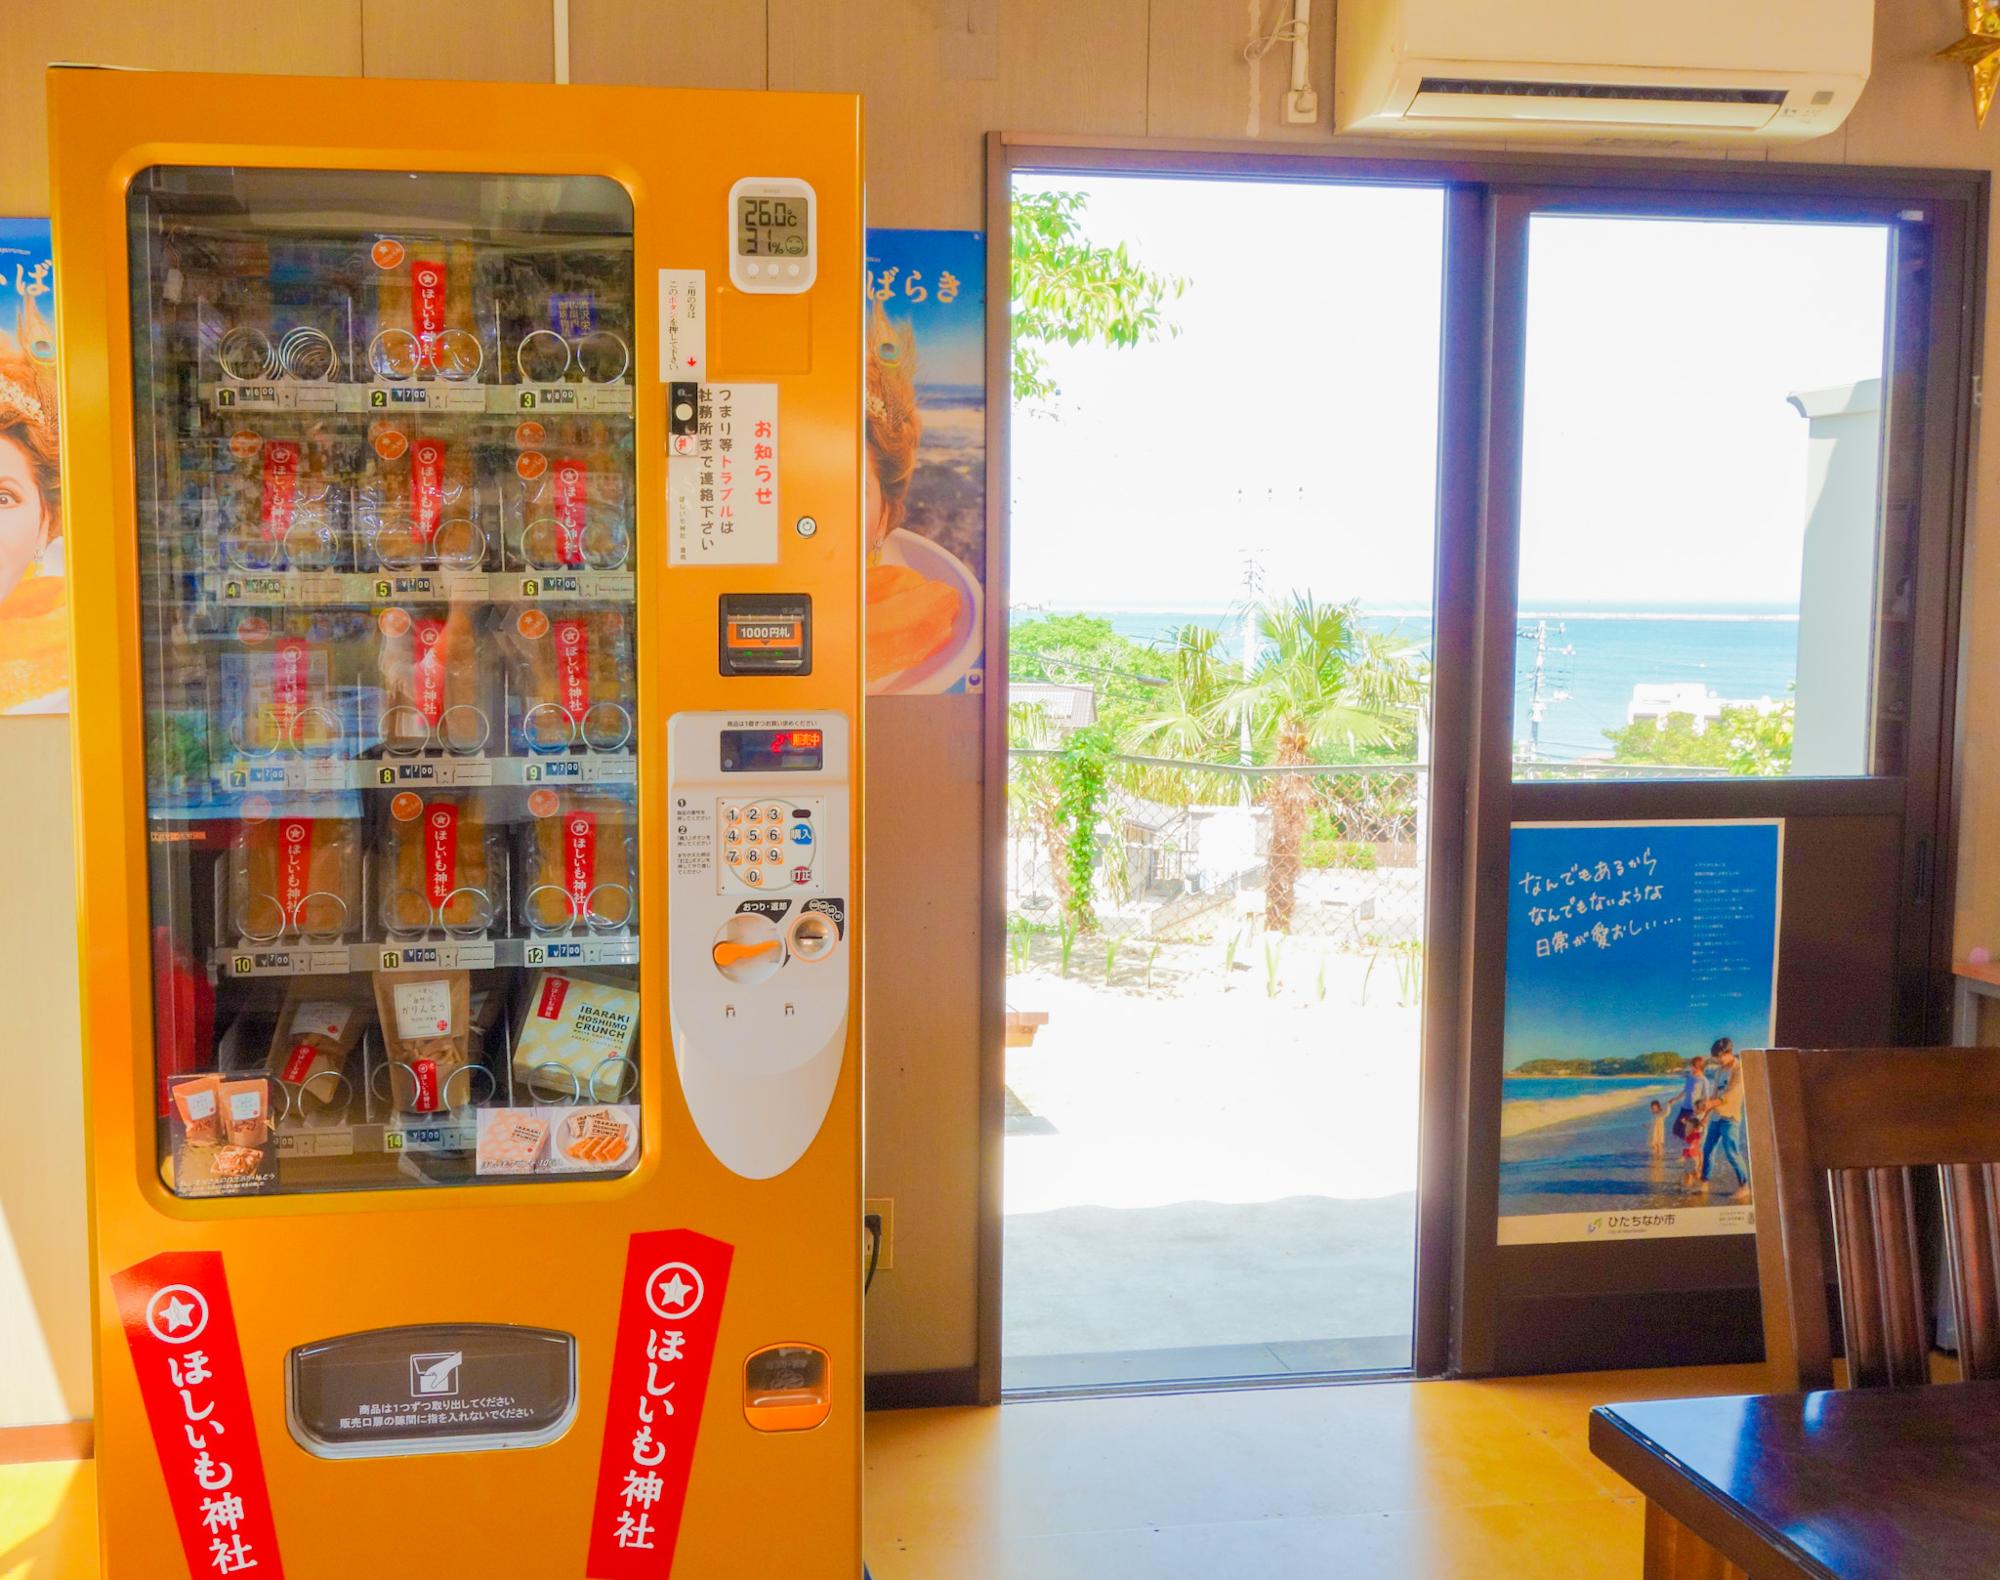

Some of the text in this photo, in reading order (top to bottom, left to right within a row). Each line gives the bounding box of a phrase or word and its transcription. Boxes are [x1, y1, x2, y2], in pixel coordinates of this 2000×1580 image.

[744, 227, 785, 254] 31%
[867, 266, 961, 303] ばらき
[222, 389, 231, 405] 1
[374, 391, 384, 406] 2
[524, 393, 533, 407] 3
[718, 388, 735, 535] つまり等トラブルは
[754, 420, 773, 505] お知らせ
[698, 387, 715, 552] 社務所まで連絡下さい
[227, 583, 236, 597] 4
[378, 584, 388, 597] 5
[526, 581, 535, 595] 6
[740, 627, 791, 638] 1000円札
[565, 646, 583, 711] ほしいも神社
[234, 773, 242, 785] 7
[383, 769, 391, 783] 8
[530, 766, 538, 780] 9
[729, 809, 737, 820] 1
[750, 809, 758, 820] 2
[770, 808, 779, 820] 3
[728, 830, 737, 842] 4
[750, 829, 758, 841] 5
[770, 829, 779, 841] 6
[729, 852, 737, 863] 7
[750, 851, 758, 862] 8
[770, 850, 779, 862] 9
[434, 830, 448, 897] ほしいも神社
[573, 838, 587, 904] ほしいも神社
[749, 871, 758, 883] 0
[1519, 848, 1657, 896] なんでもあるから
[287, 846, 301, 914] ほしいも神社
[743, 902, 787, 911] おつり・返却
[1528, 885, 1664, 926] なんでもないような
[384, 954, 397, 968] 11
[529, 949, 543, 963] 12
[235, 959, 250, 972] 10
[580, 1005, 630, 1023] IBARAKI
[577, 1014, 628, 1031] HOSHIIMO
[575, 1022, 625, 1039] CRUNCH
[388, 1135, 401, 1147] 14
[1608, 1214, 1676, 1228] ひたちなか市
[359, 1397, 515, 1415] 商品は1つずつ取り出してください
[613, 1329, 685, 1549] ほしいも神社
[168, 1350, 258, 1575] ほしいも神社
